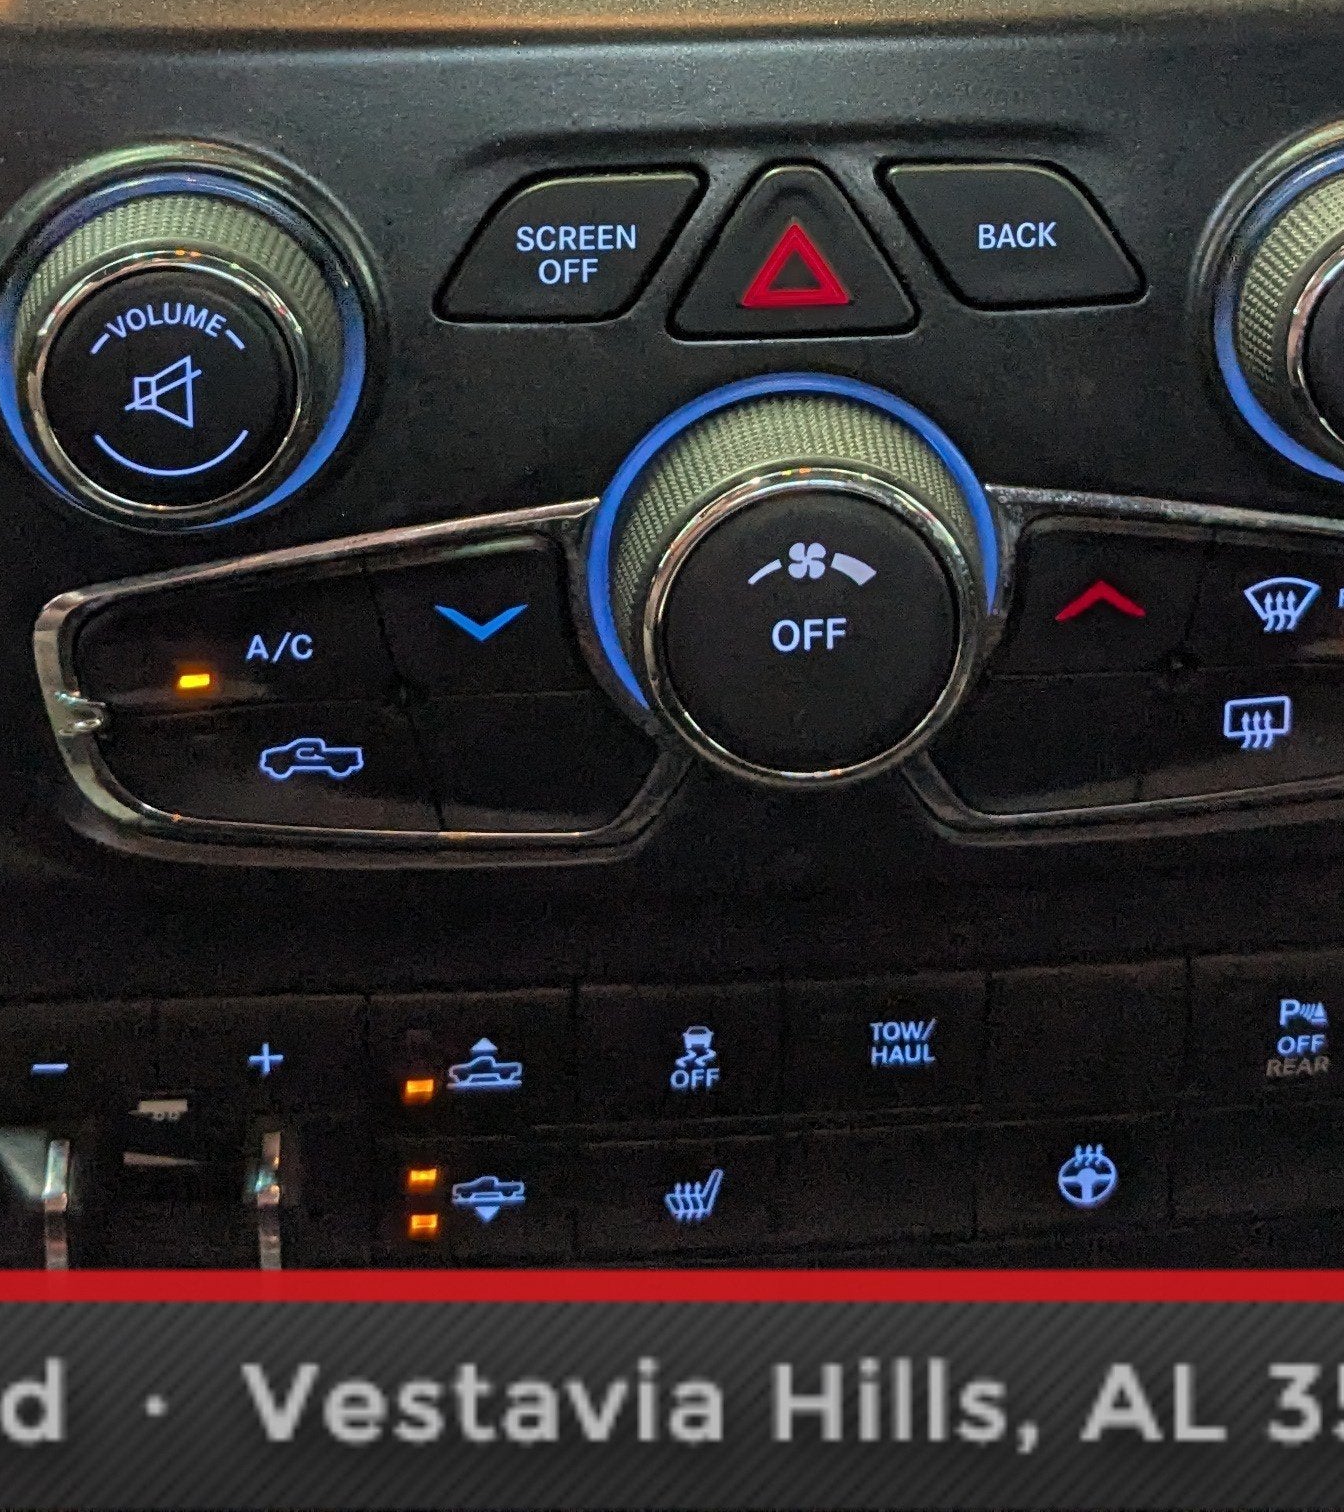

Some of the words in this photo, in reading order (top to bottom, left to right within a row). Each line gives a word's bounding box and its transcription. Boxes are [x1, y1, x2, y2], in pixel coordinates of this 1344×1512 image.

[516, 225, 636, 251] SCREEN
[977, 222, 1057, 249] BACK
[538, 259, 598, 285] OFF
[106, 303, 227, 339] VOLUME
[247, 632, 313, 661] A/C
[772, 618, 847, 653] OFF
[870, 1018, 938, 1043] TOW/
[870, 1043, 935, 1066] HAUL
[1277, 1034, 1325, 1055] OFF
[671, 1068, 718, 1088] OFF
[1266, 1055, 1329, 1078] REAR
